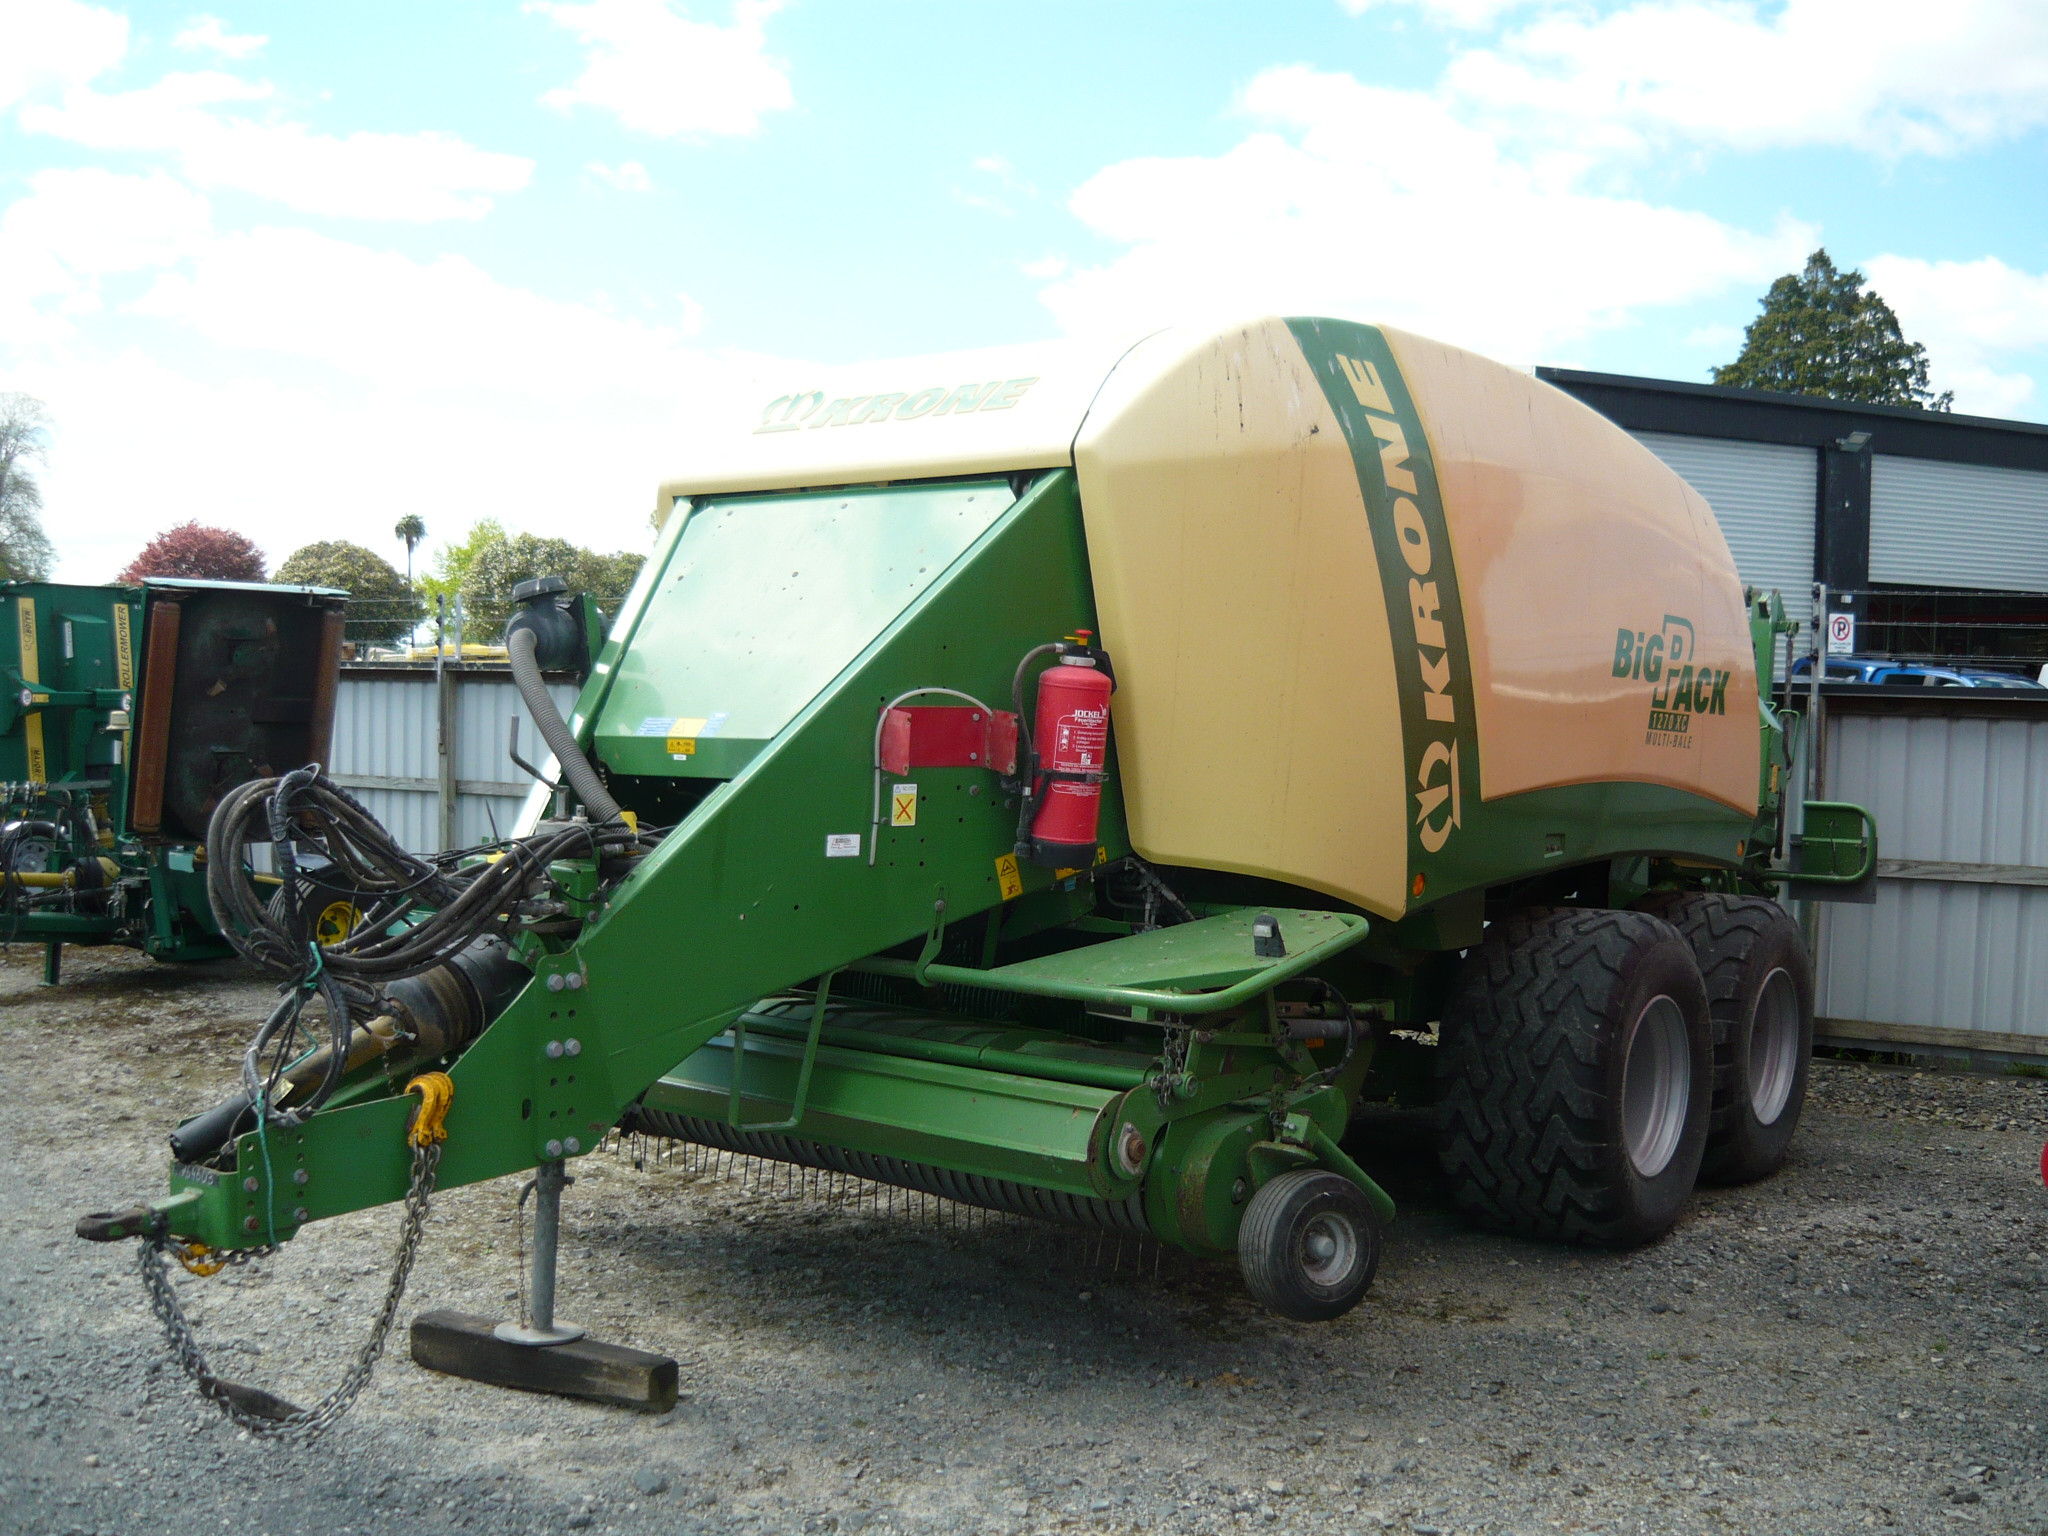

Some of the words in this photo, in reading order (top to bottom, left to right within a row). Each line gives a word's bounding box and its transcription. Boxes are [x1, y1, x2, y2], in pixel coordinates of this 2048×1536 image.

[808, 376, 1041, 429] KRONE
[1336, 353, 1456, 723] KRONE
[118, 606, 131, 688] ROLLERMOWER
[1074, 710, 1101, 718] JOCKEL
[1652, 712, 1675, 730] 1270
[1645, 731, 1692, 749] MULTI-BALE
[34, 749, 42, 774] MAJOR
